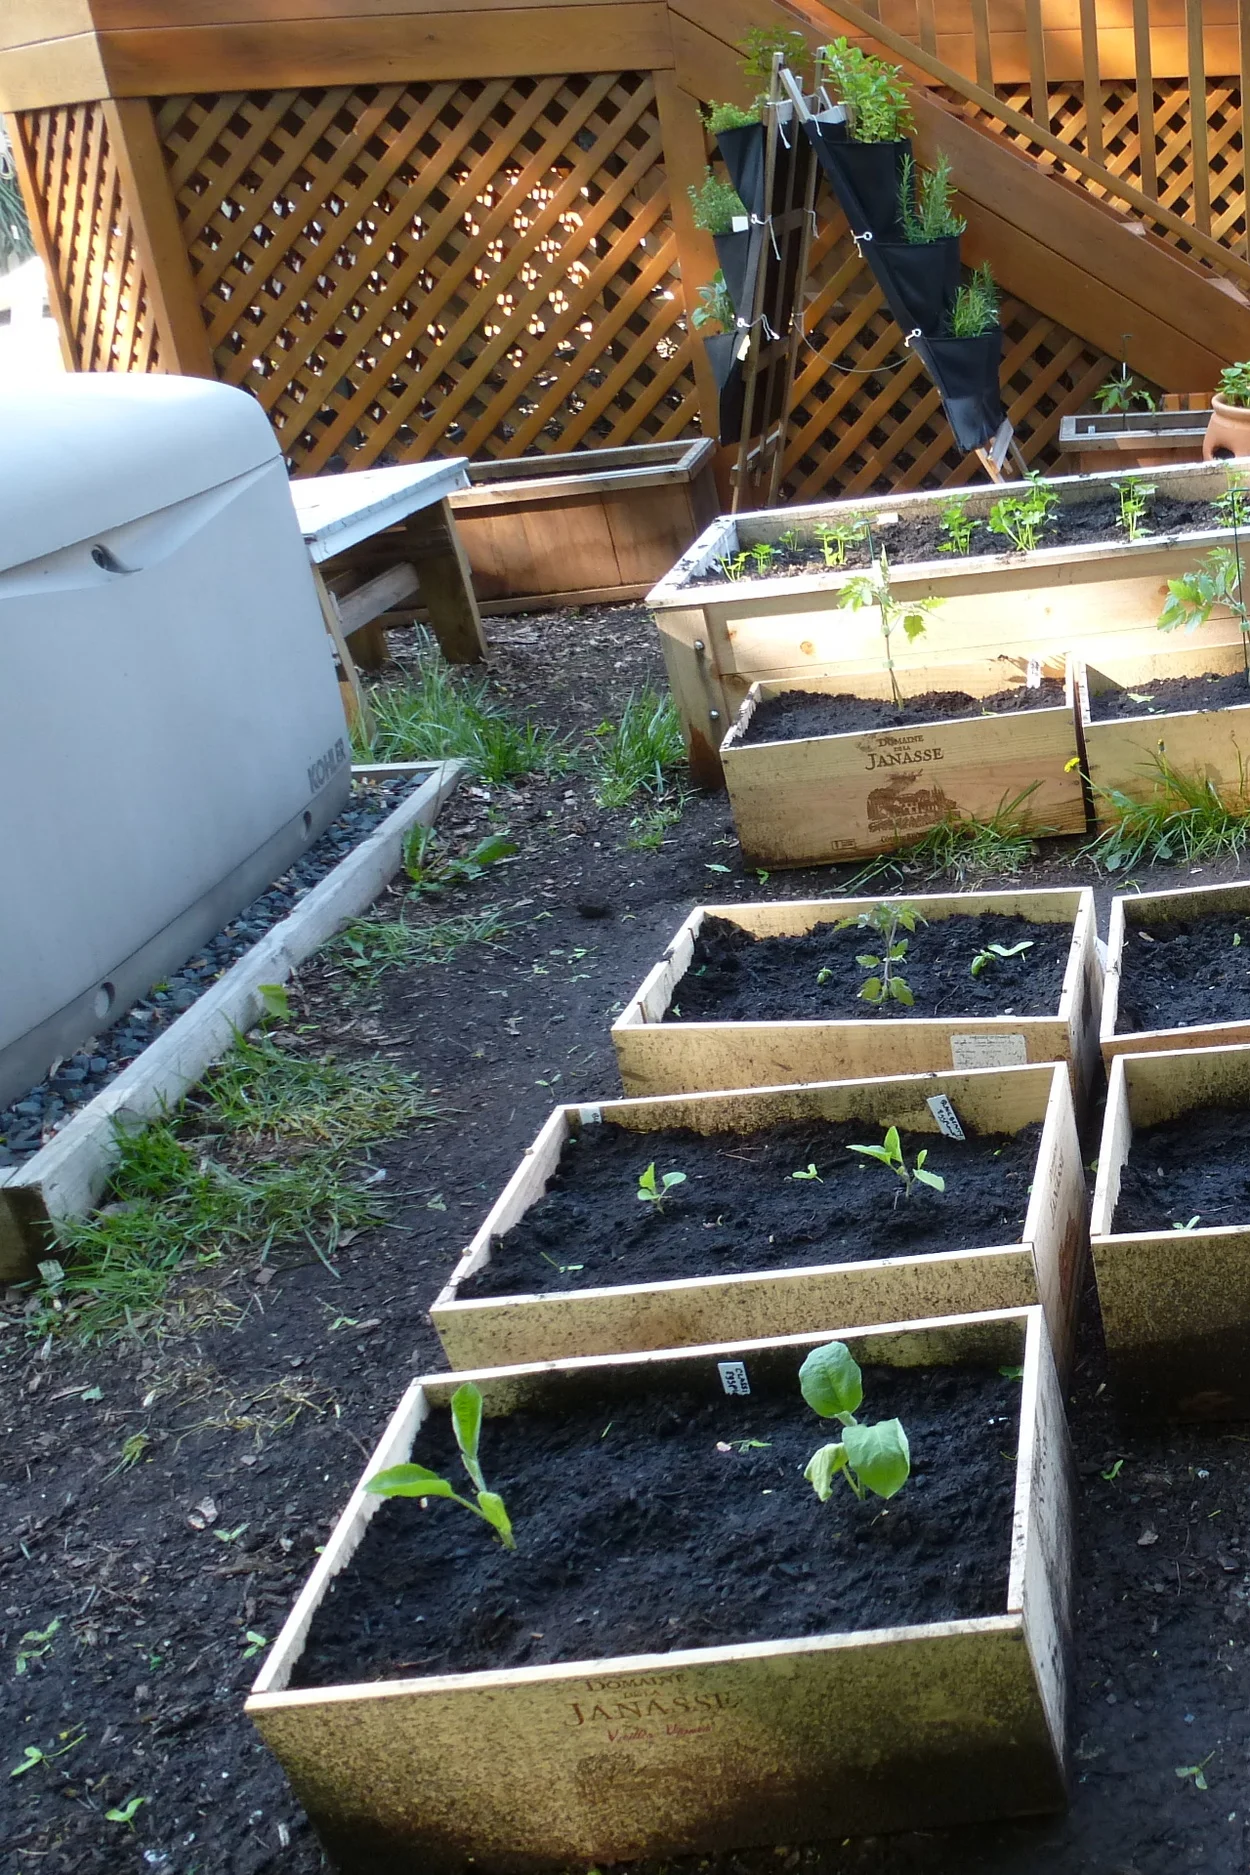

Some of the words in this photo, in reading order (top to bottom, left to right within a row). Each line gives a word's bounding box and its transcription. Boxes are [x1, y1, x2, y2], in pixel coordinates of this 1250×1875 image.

[877, 735, 924, 747] DOMAINE
[307, 737, 346, 793] KOHLER
[865, 748, 944, 770] JANASSE
[584, 1673, 688, 1692] DOMAINE
[563, 1691, 742, 1726] JANASSE
